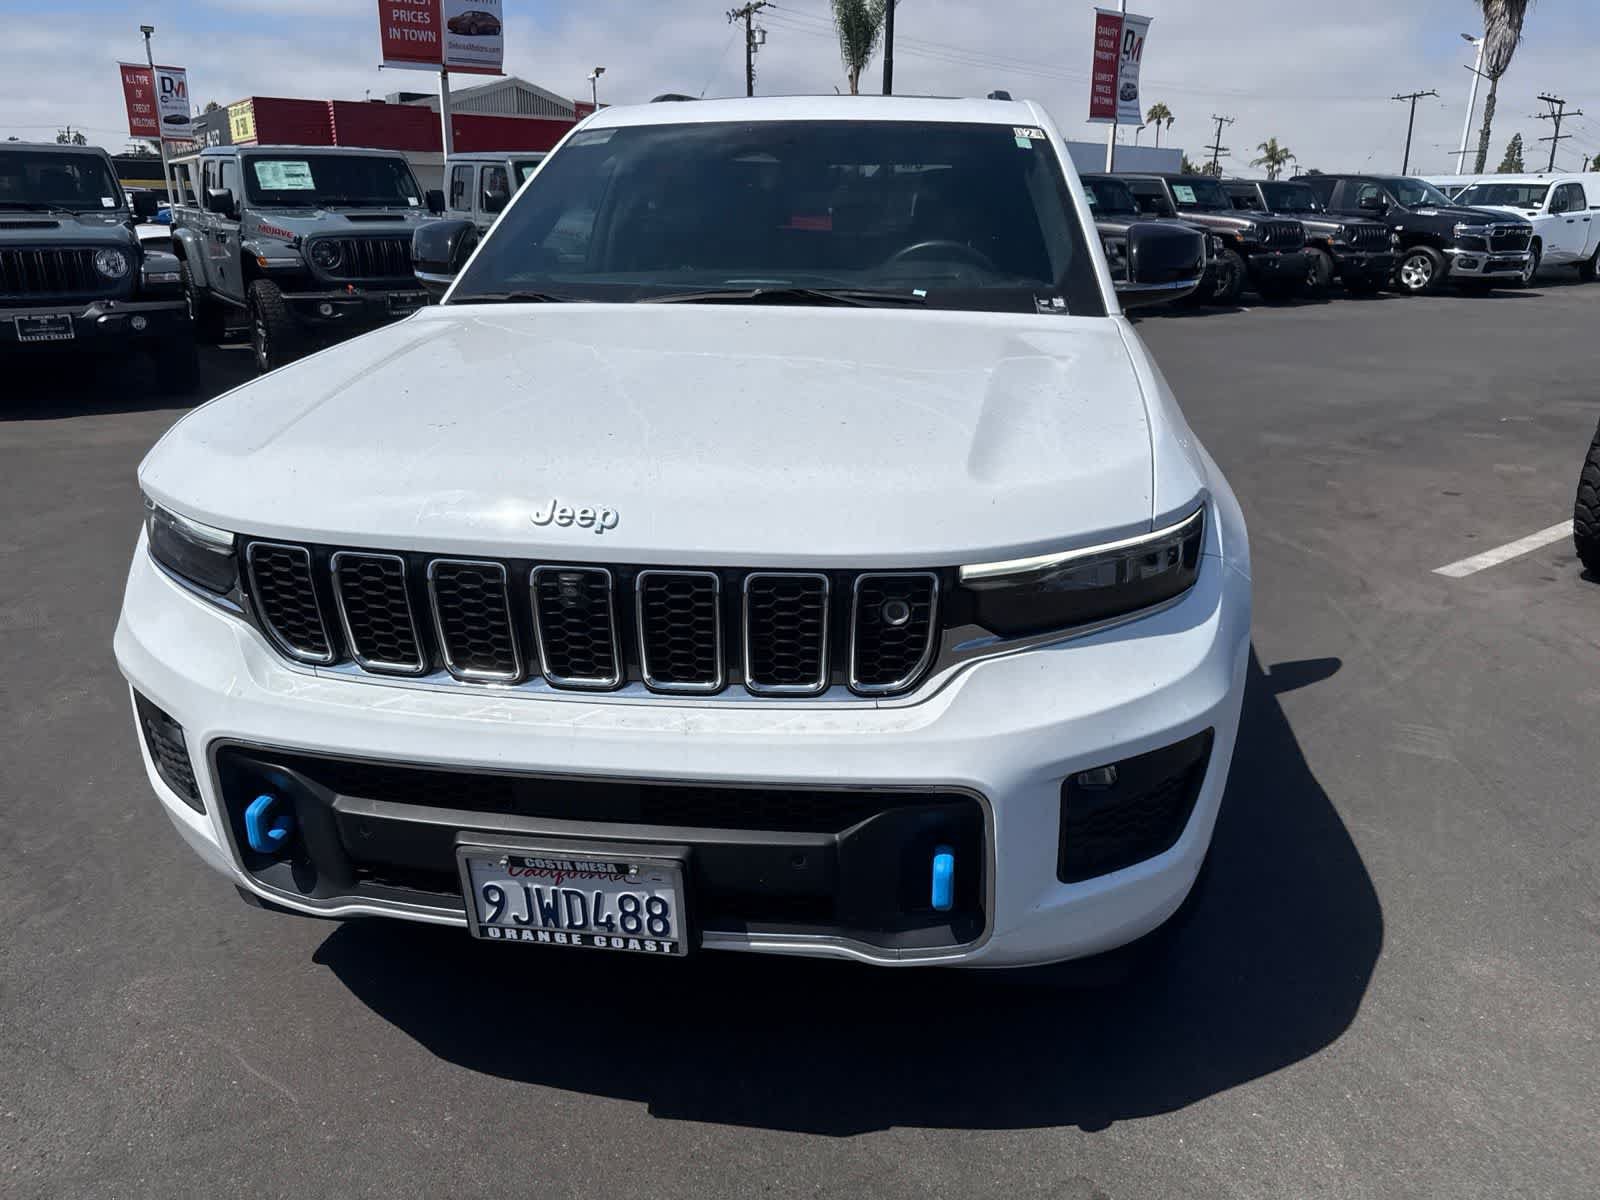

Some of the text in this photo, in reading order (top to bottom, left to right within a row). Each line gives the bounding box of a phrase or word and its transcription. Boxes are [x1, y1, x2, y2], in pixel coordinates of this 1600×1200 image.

[392, 9, 431, 24] PRICES
[389, 27, 436, 42] IN TOWN
[257, 223, 295, 238] MOJAVE
[529, 497, 620, 535] Jeep
[523, 857, 618, 874] COSTA MESA
[482, 884, 671, 937] 9JWD488
[488, 927, 673, 953] ORANGE COAST
